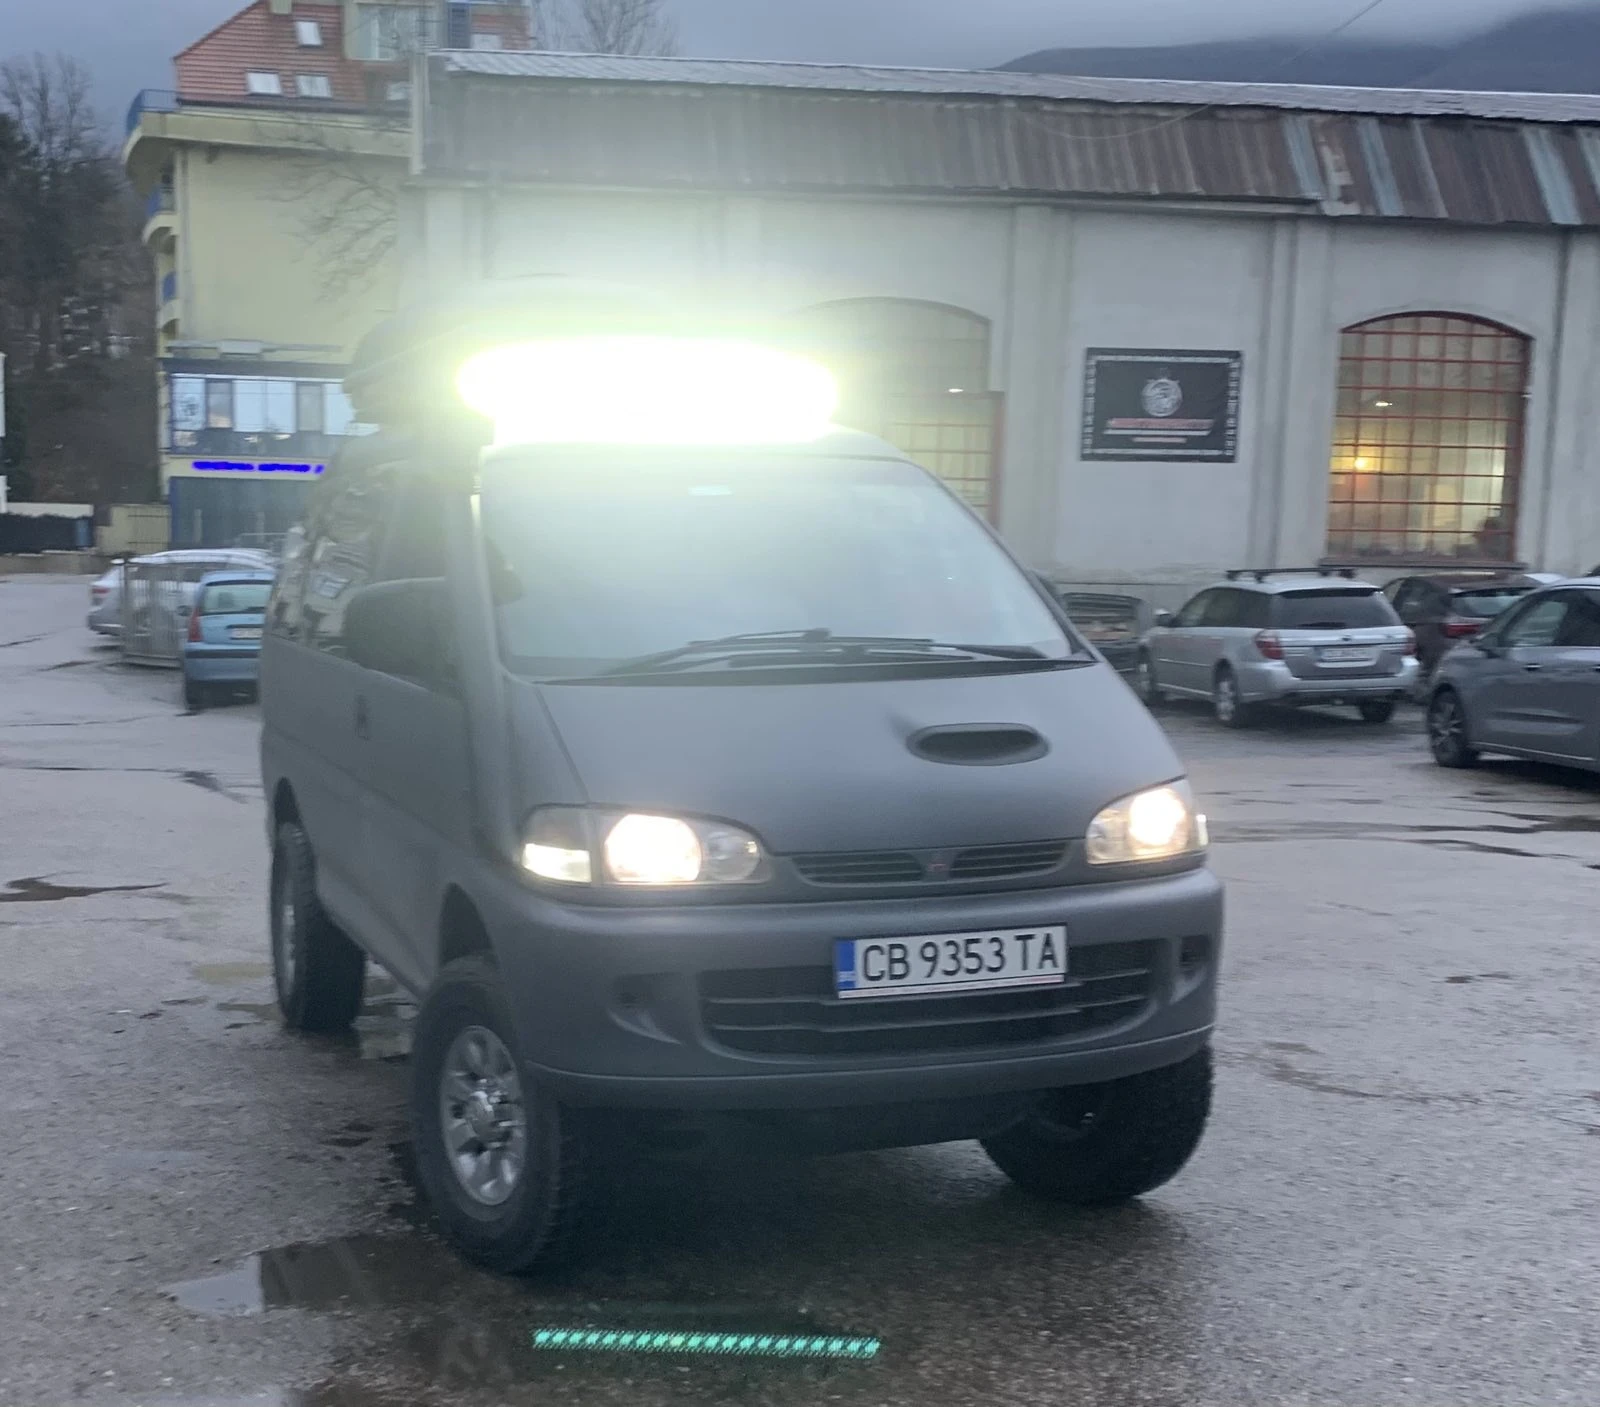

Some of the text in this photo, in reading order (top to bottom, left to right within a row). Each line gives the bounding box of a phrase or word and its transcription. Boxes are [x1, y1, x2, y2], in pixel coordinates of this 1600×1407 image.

[862, 932, 1059, 982] CB 9353 TA
